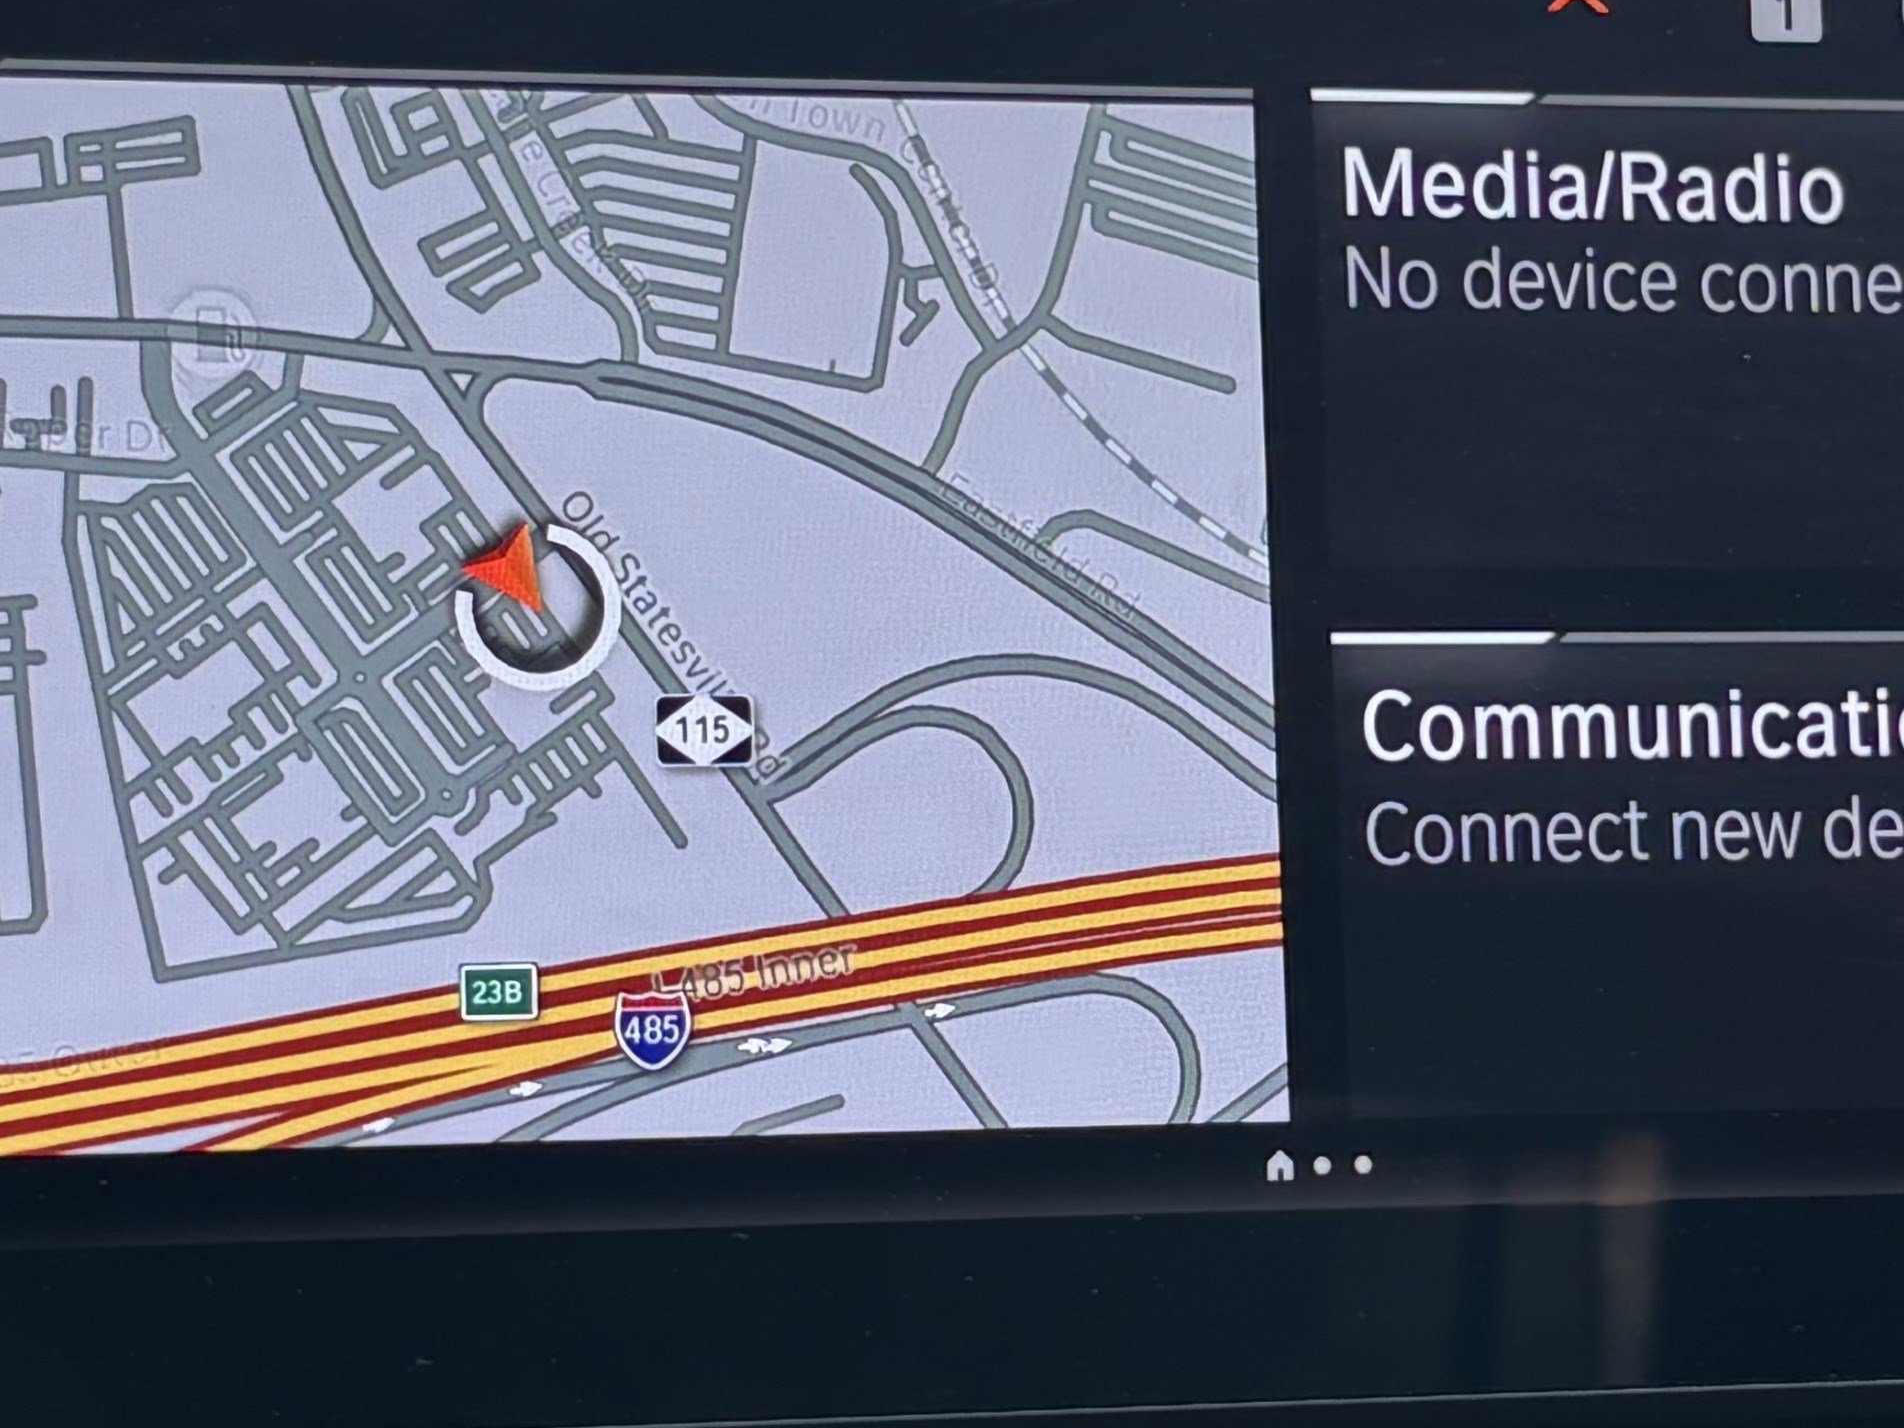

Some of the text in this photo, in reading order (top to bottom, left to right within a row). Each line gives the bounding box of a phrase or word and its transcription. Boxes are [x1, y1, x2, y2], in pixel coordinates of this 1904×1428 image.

[1343, 145, 1846, 227] Media/Radio
[1345, 244, 1439, 311] No
[1462, 244, 1678, 314] device
[562, 490, 621, 552] Old
[616, 551, 736, 694] Statesvil
[675, 714, 730, 744] 115
[1365, 799, 1651, 867] Connect
[1671, 808, 1803, 862] new
[471, 979, 522, 1005] 23B
[755, 945, 857, 990] Inner
[625, 1014, 680, 1045] 485
